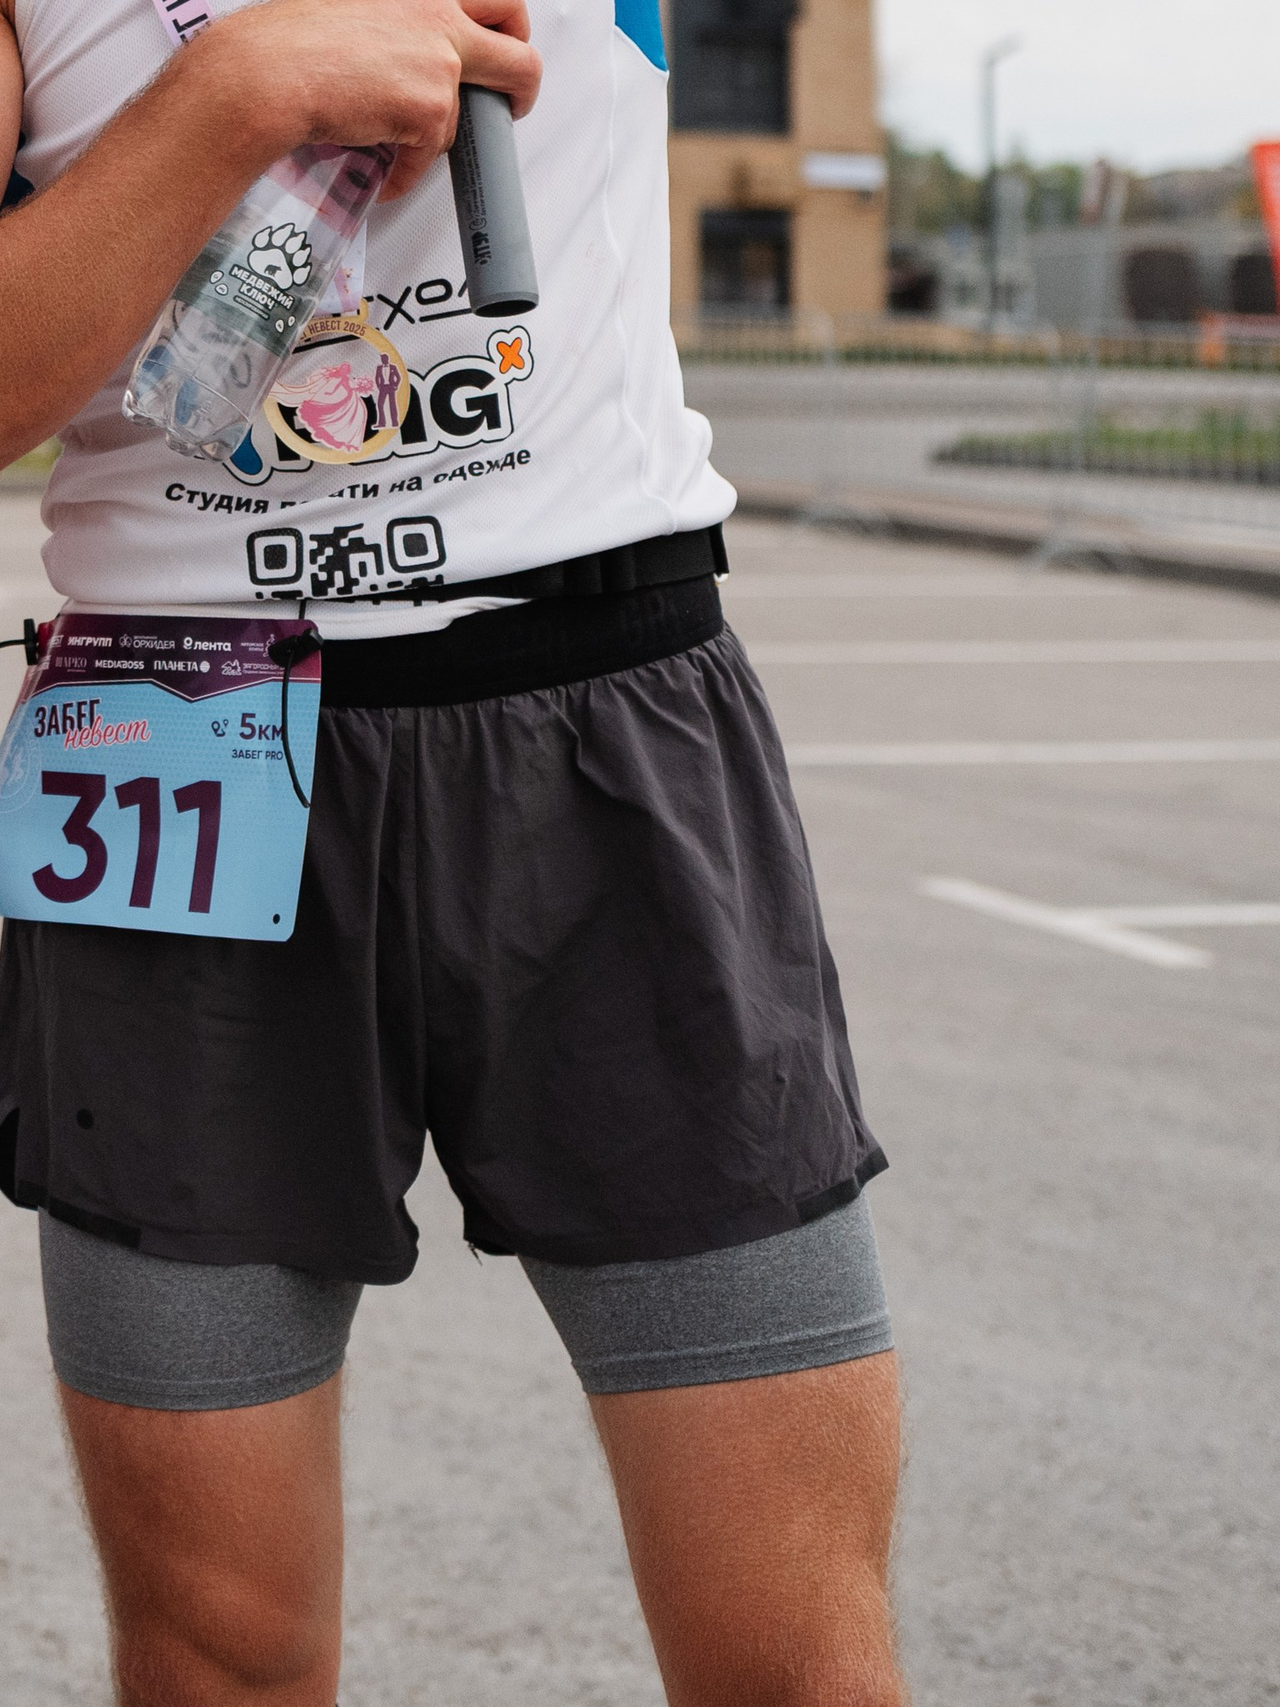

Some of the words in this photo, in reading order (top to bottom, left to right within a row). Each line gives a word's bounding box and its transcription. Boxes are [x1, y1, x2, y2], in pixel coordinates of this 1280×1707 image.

[231, 267, 294, 309] МЕДВЕЖИЙ
[240, 283, 275, 310] КЛЮЧ
[308, 321, 341, 334] НЕВЕСТ
[343, 321, 367, 336] 2025
[166, 483, 269, 514] Студия
[389, 472, 423, 494] на
[432, 449, 532, 484] одежде
[67, 636, 113, 647] ИНГРУПП
[133, 639, 175, 650] ОРХИДЕЯ
[193, 640, 232, 652] лента
[95, 659, 145, 670] MEDIABOSS
[154, 660, 198, 672] ПЛАНЕТА
[34, 698, 100, 737] ЗАБЕГ
[64, 715, 151, 750] невест
[231, 749, 262, 759] ЗАБЕГ
[265, 750, 284, 761] PRO
[32, 770, 222, 914] 311
